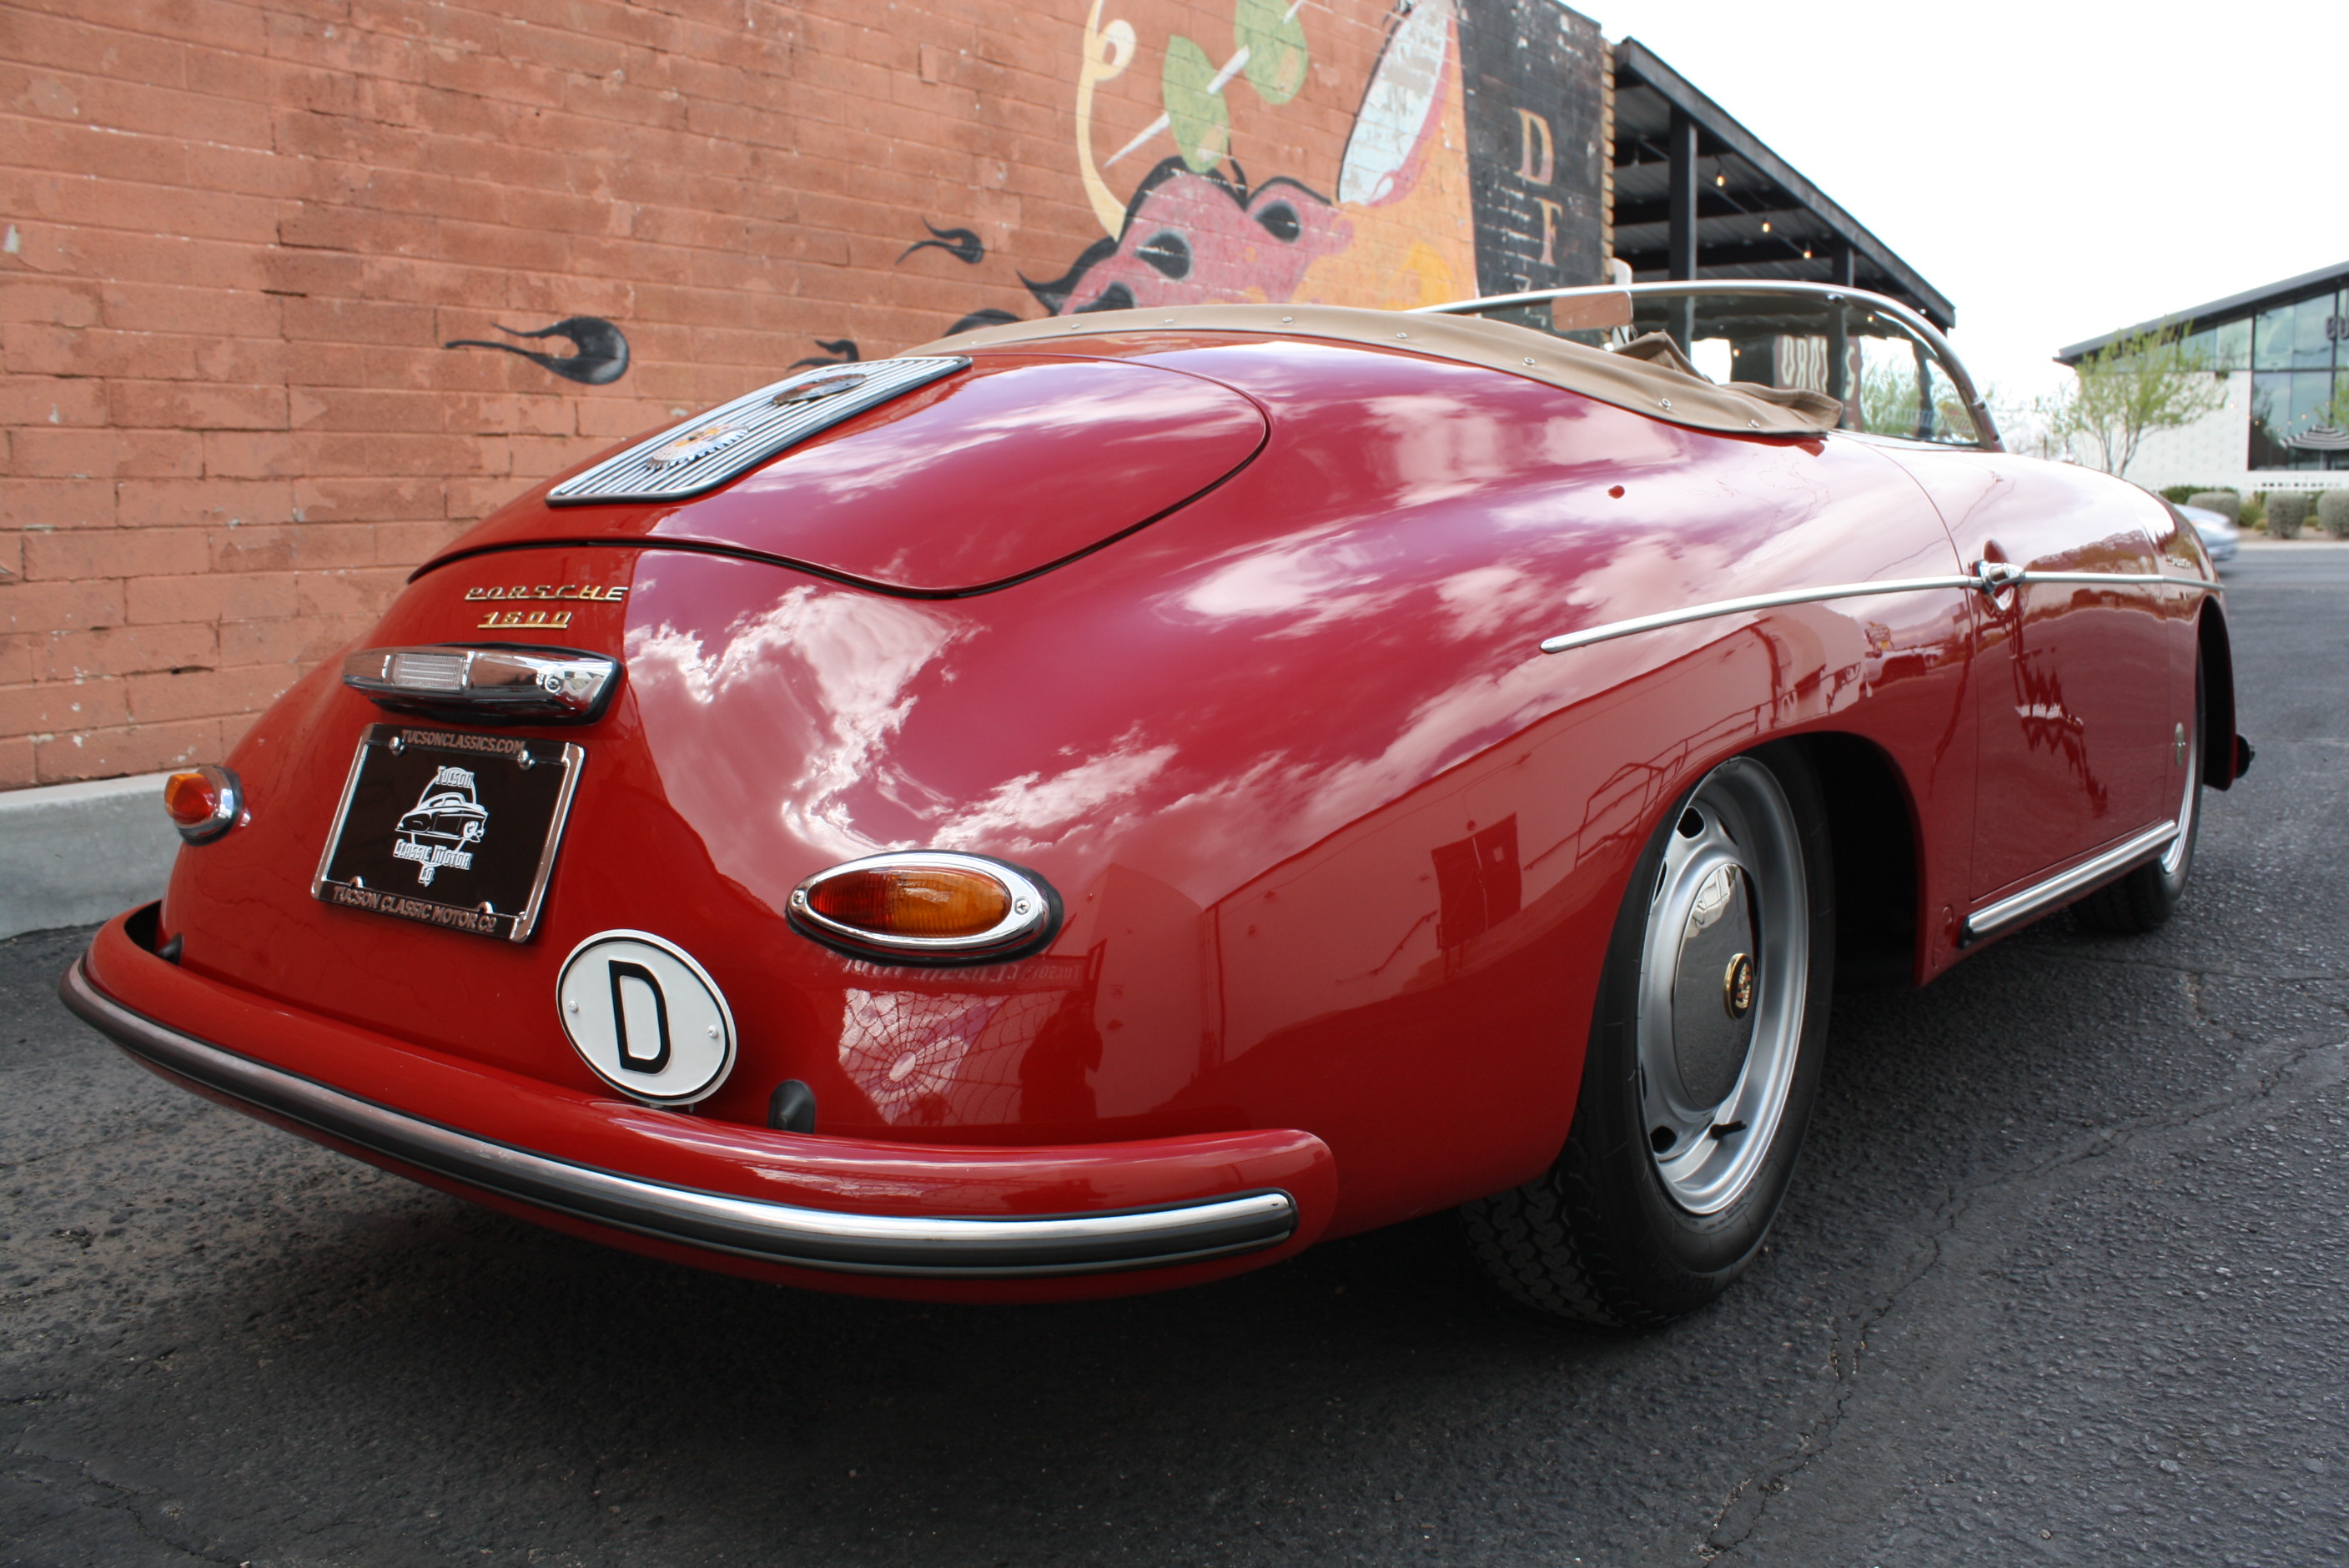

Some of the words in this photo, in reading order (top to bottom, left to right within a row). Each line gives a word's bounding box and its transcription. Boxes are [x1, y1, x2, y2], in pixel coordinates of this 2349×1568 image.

[465, 585, 629, 601] PORSCHE
[478, 611, 572, 628] 1600
[401, 729, 526, 754] TUCSONCLASSICS.COM
[334, 886, 381, 909] TUCSON
[380, 895, 433, 920] CLASSIC
[431, 906, 478, 929] MOTOR
[608, 960, 672, 1074] D
